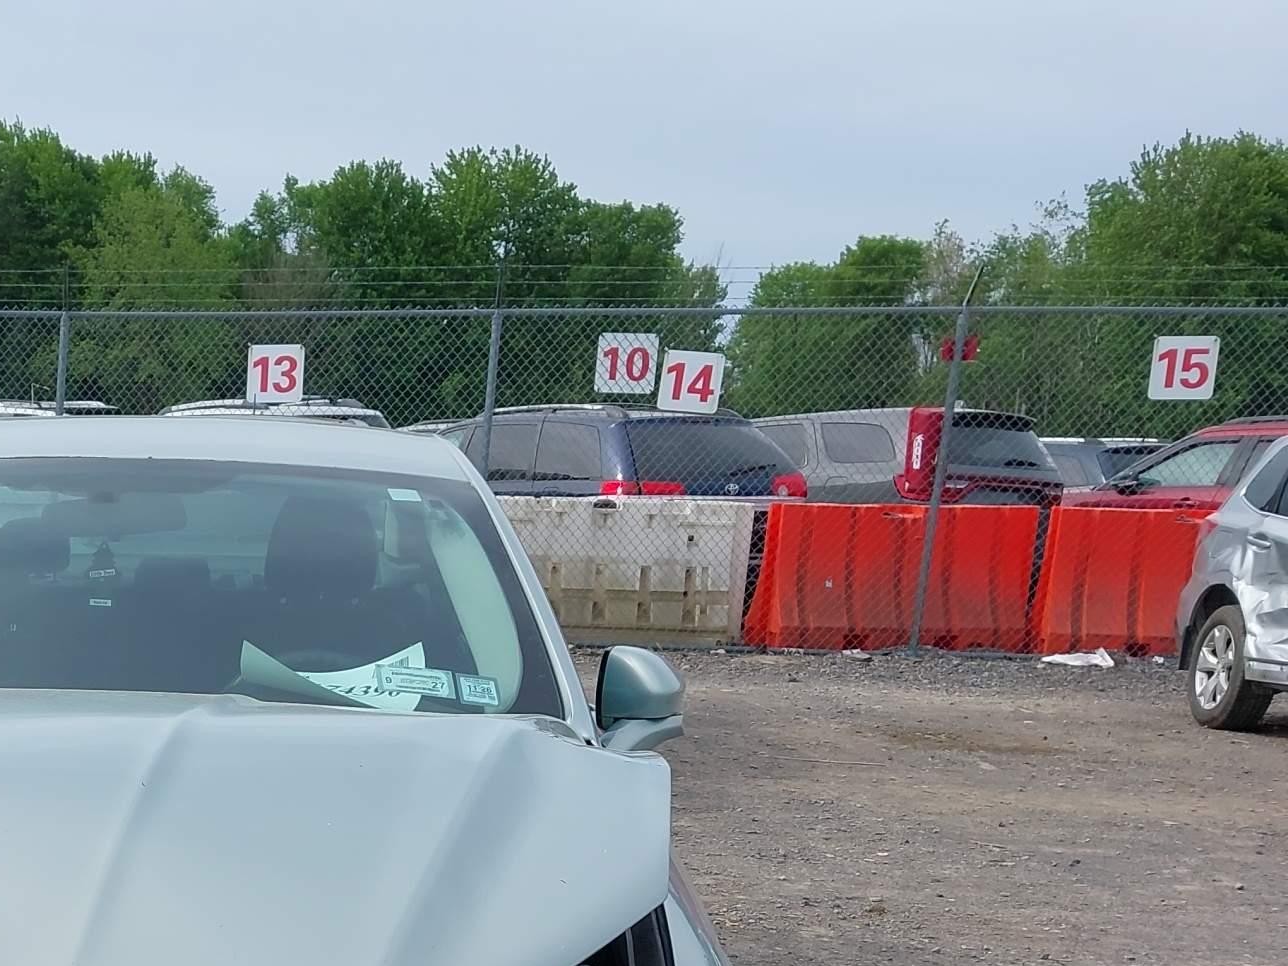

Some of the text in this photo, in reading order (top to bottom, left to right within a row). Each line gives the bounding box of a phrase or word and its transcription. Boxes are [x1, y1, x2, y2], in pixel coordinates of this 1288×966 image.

[253, 355, 298, 393] 13
[604, 347, 650, 382] 10
[667, 362, 714, 403] 14
[1158, 348, 1210, 389] 15
